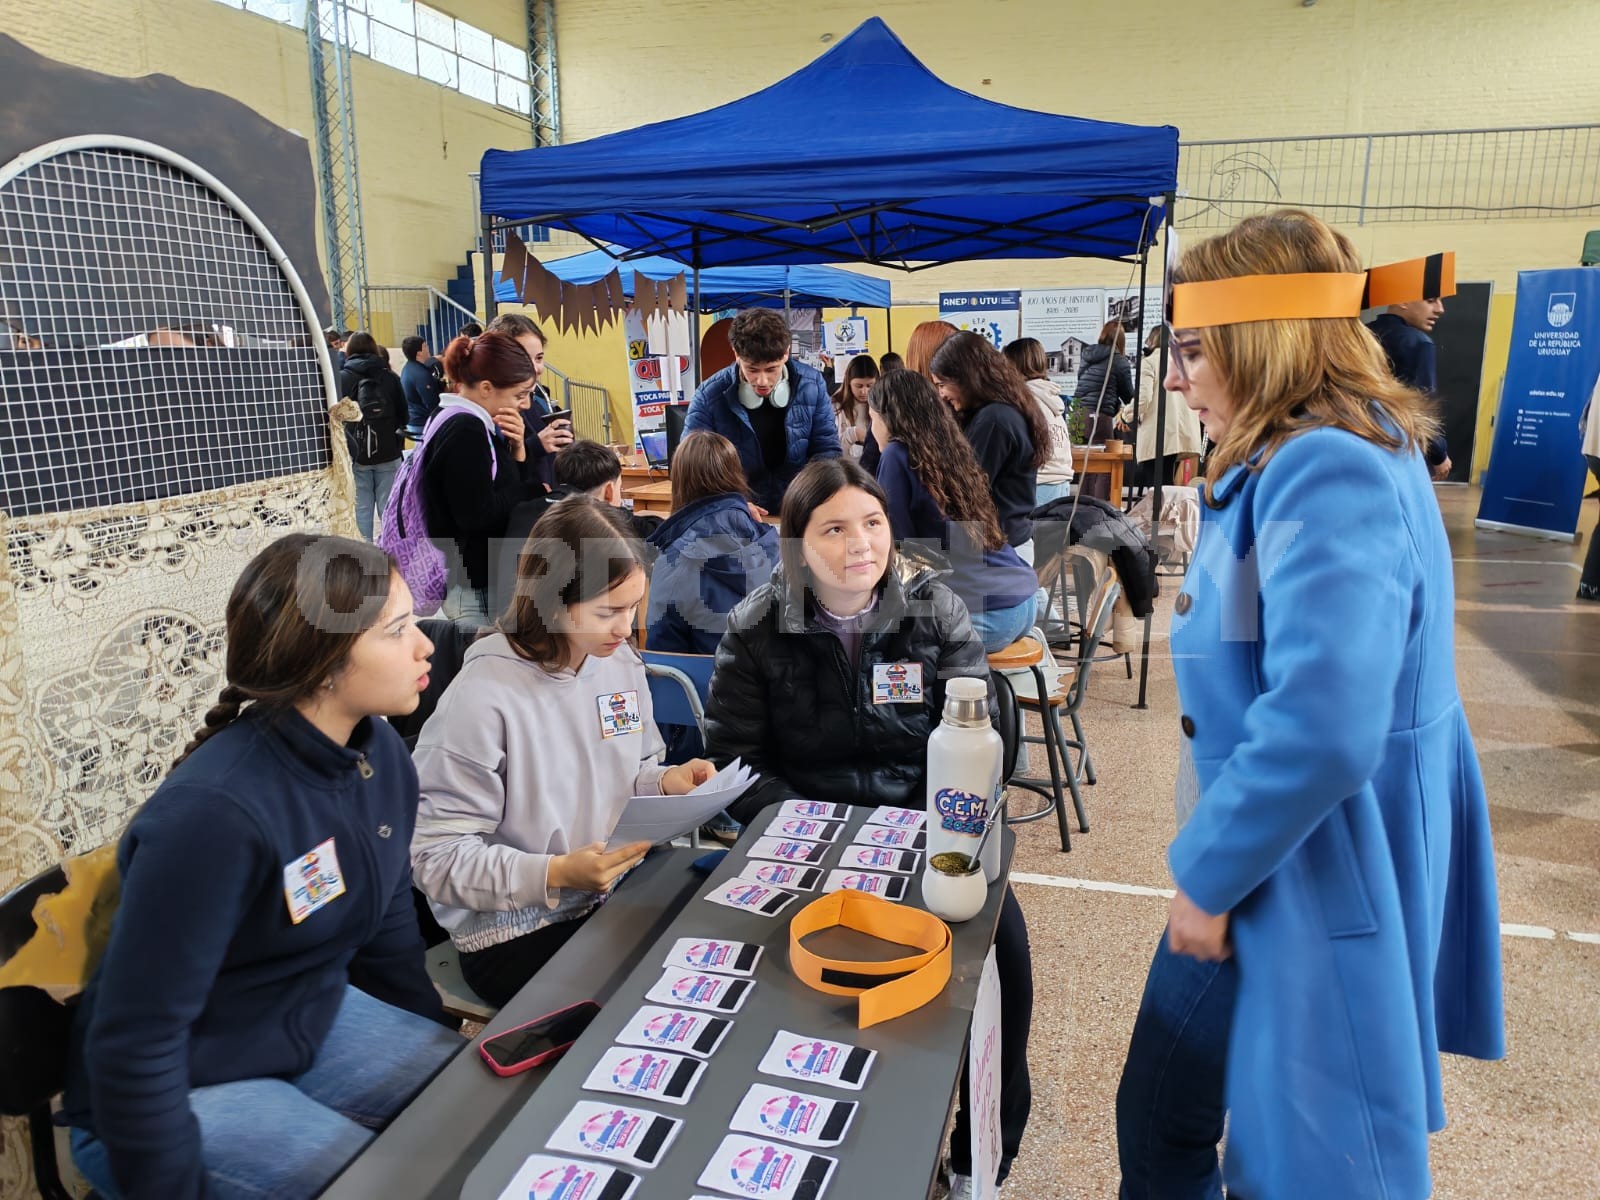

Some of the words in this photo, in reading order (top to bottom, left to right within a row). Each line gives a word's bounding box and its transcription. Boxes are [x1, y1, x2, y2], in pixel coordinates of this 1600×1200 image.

[943, 297, 967, 306] ANEP
[979, 296, 998, 305] UTU
[1027, 297, 1038, 305] 100
[1039, 295, 1058, 304] AÑOS
[1058, 296, 1067, 304] DE
[1068, 295, 1099, 304] HISTORIA
[1534, 331, 1579, 339] UNIVERSIDAD
[1547, 339, 1581, 347] REPÚBLICA
[1537, 348, 1571, 356] URUGUAY
[638, 393, 657, 402] TOCA
[642, 405, 660, 414] TOCA
[943, 816, 985, 833] 2026
